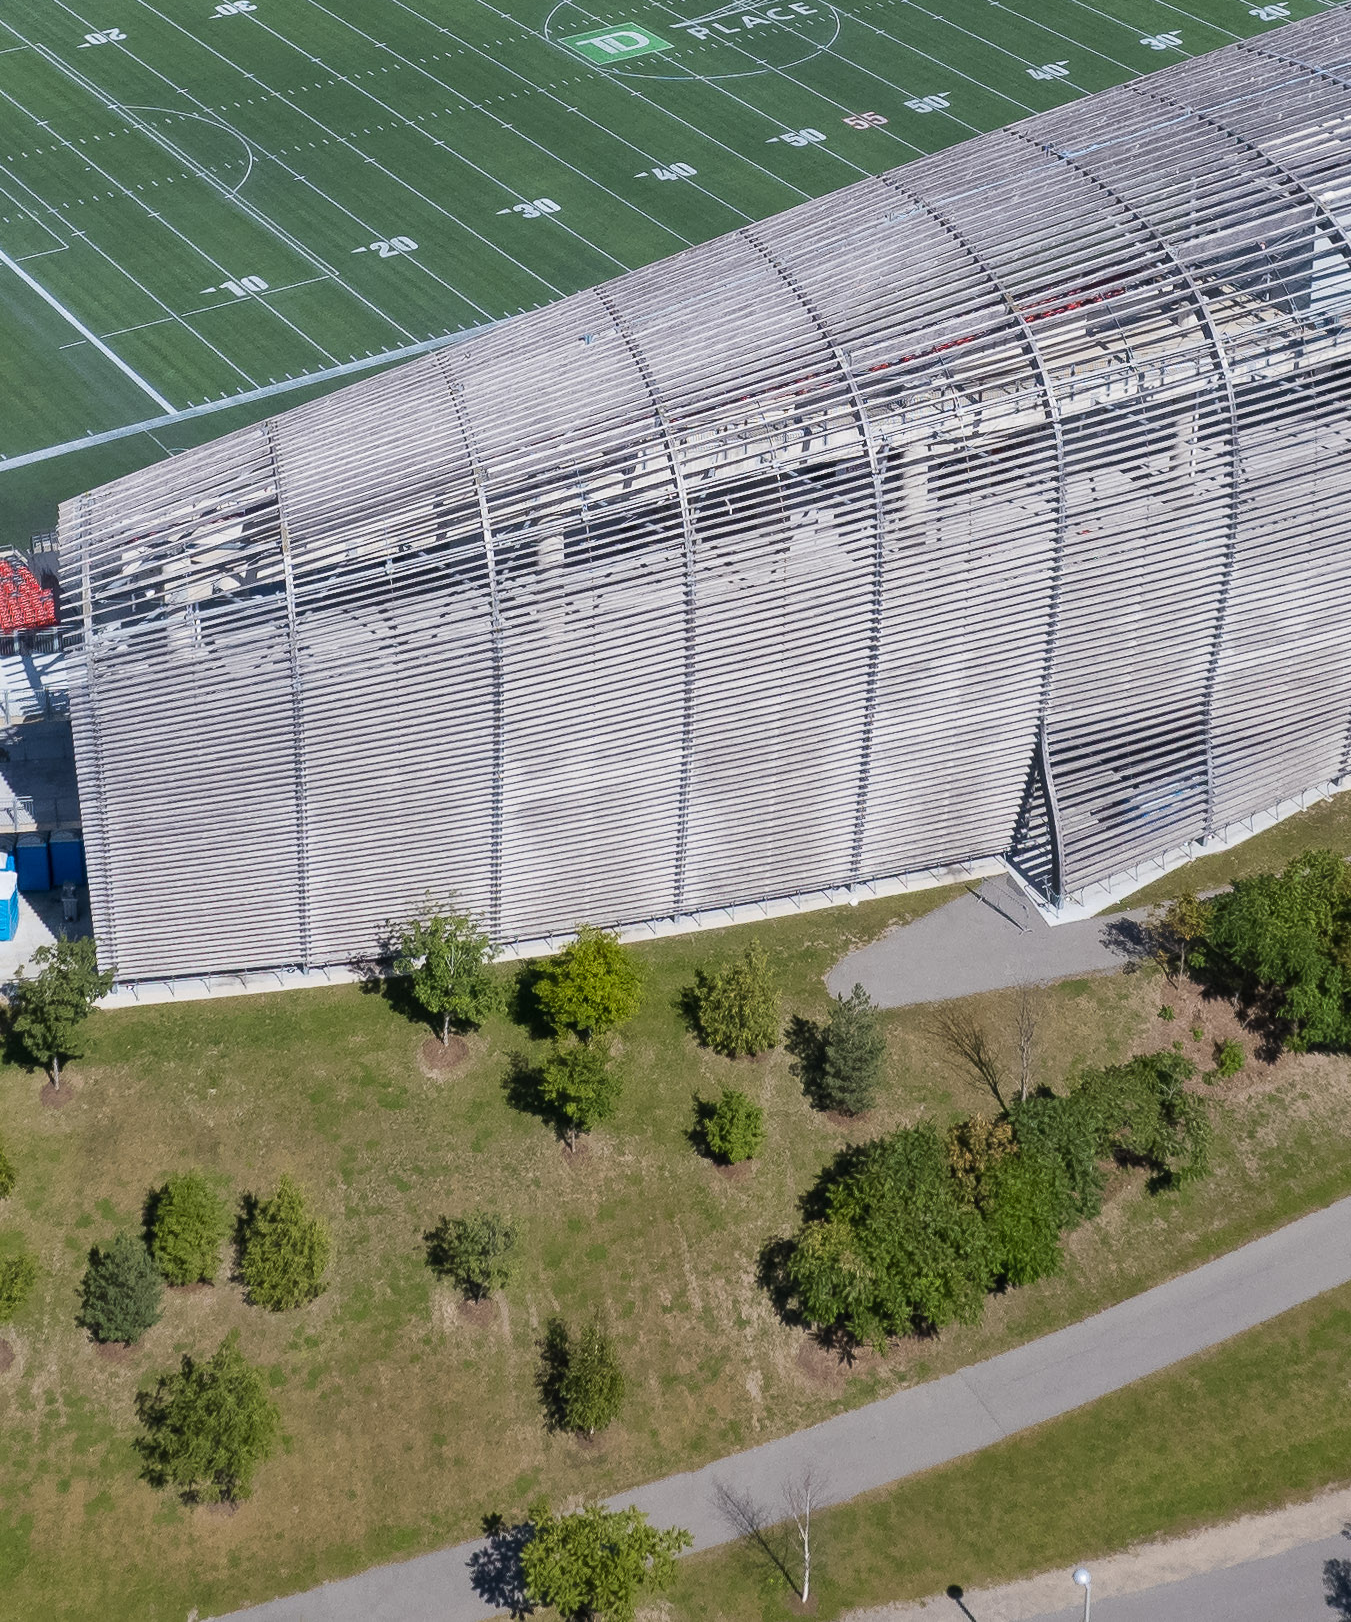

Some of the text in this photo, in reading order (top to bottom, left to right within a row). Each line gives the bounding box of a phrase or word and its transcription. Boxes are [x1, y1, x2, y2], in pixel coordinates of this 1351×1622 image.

[214, 0, 258, 16] 30
[1248, 4, 1292, 22] 20
[686, 2, 818, 40] PLACE
[84, 28, 128, 44] 20
[575, 31, 650, 56] TD
[1140, 33, 1184, 51] 30
[1026, 64, 1070, 80] 40
[903, 95, 952, 114] 50
[842, 110, 890, 131] 55
[779, 128, 827, 148] 50
[652, 162, 698, 182] 40
[512, 197, 562, 220] 30
[370, 236, 419, 258] 20
[219, 275, 269, 297] 10
